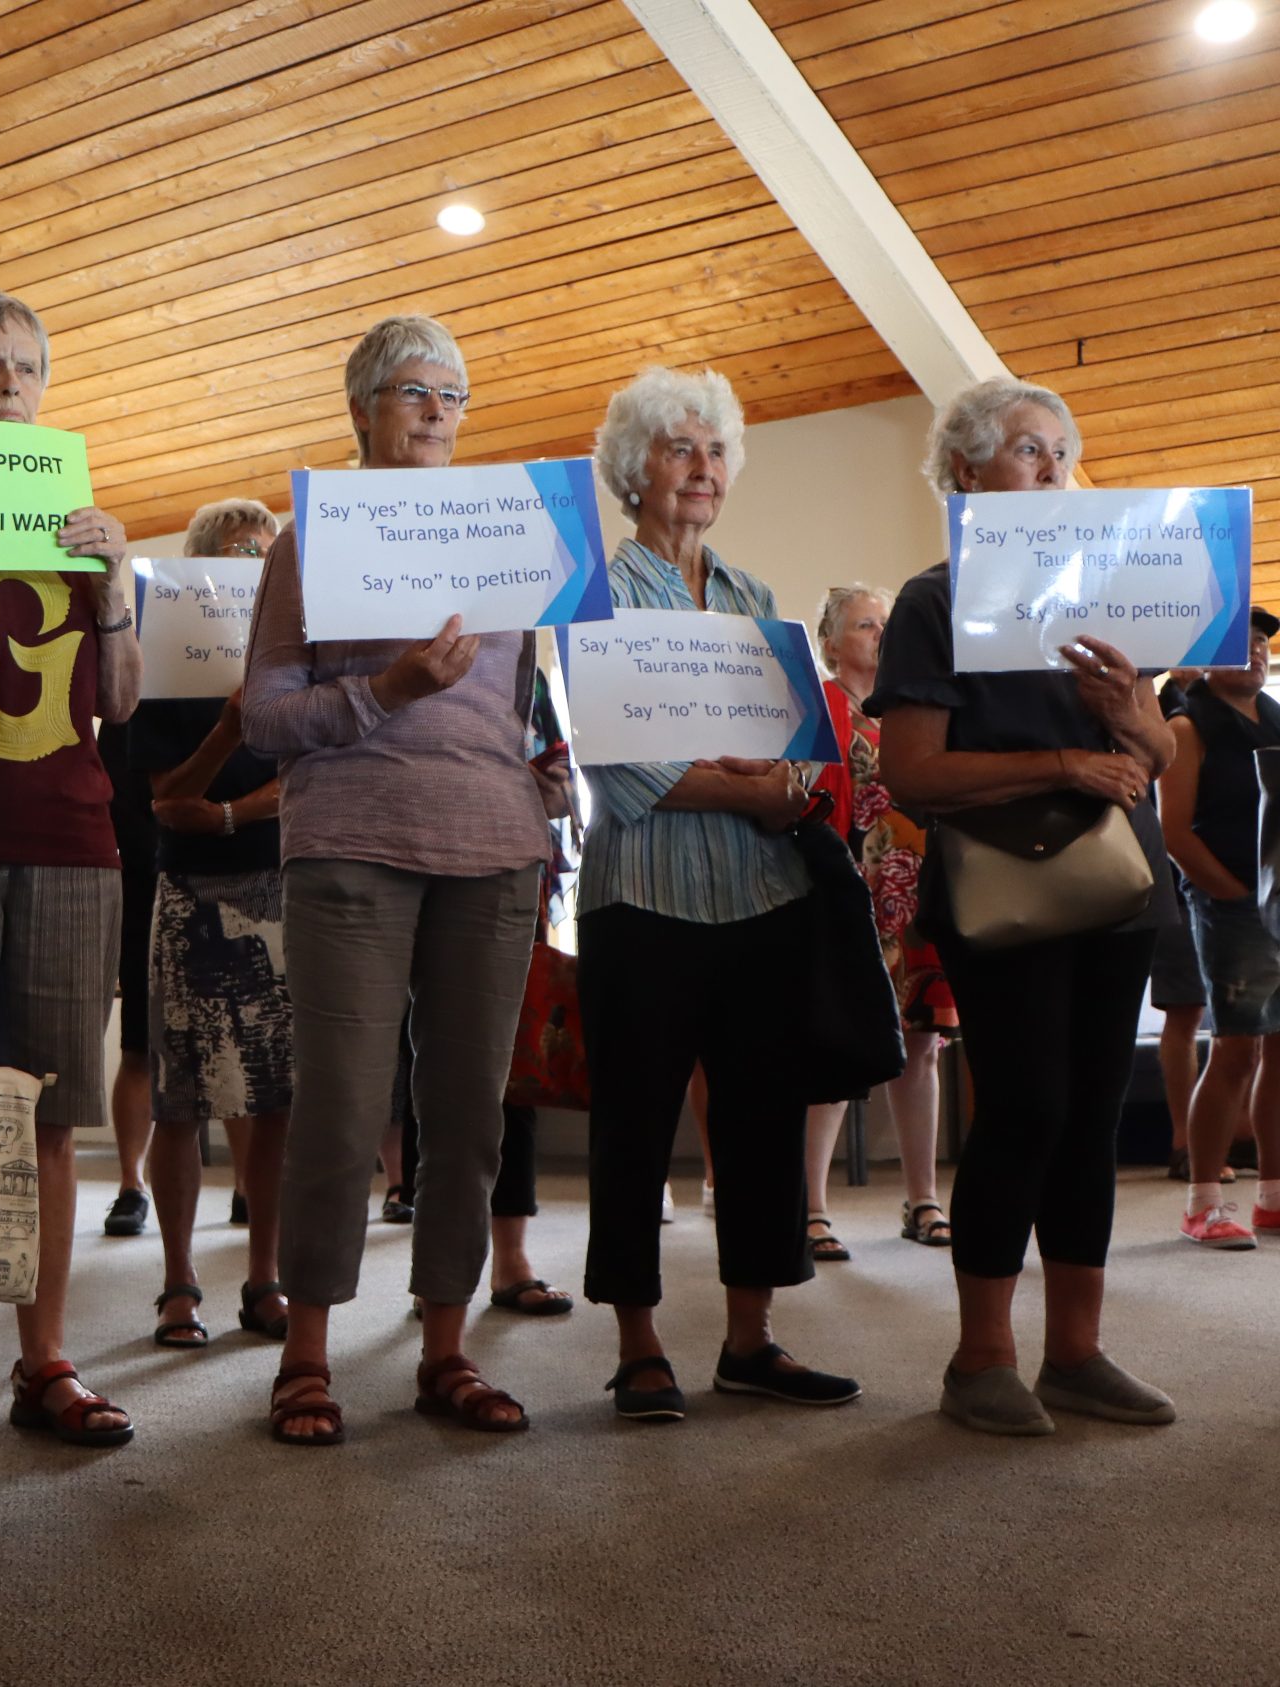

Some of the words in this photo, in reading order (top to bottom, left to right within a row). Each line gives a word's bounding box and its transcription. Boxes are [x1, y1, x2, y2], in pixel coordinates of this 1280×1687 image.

[319, 502, 350, 522] Say
[357, 500, 407, 521] “yes”
[415, 501, 434, 517] to
[440, 498, 490, 516] Maori
[496, 495, 545, 512] Ward
[551, 492, 577, 508] for
[12, 512, 71, 532] WAR
[376, 525, 460, 544] Tauranga
[466, 523, 526, 539] Moana
[975, 527, 1007, 547] Say
[1015, 525, 1067, 545] “yes”
[1075, 525, 1094, 541] to
[1158, 523, 1203, 541] Ward
[1209, 522, 1233, 540] for
[1125, 550, 1183, 567] Moana
[362, 574, 394, 593] Say
[400, 573, 443, 589] “no”
[451, 573, 470, 589] to
[476, 566, 552, 591] petition
[154, 585, 180, 601] Say
[231, 585, 246, 598] to
[1107, 602, 1126, 618] to
[1131, 601, 1201, 621] petition
[185, 645, 211, 661] Say
[579, 637, 608, 655] Say
[615, 637, 660, 655] “yes”
[667, 638, 684, 652] to
[689, 638, 732, 654] Maori
[736, 641, 775, 658] Ward
[633, 658, 709, 677] Tauranga
[714, 661, 763, 677] Moana
[623, 702, 652, 721] Say
[659, 702, 697, 717] “no”
[704, 703, 722, 717] to
[728, 703, 789, 721] petition
